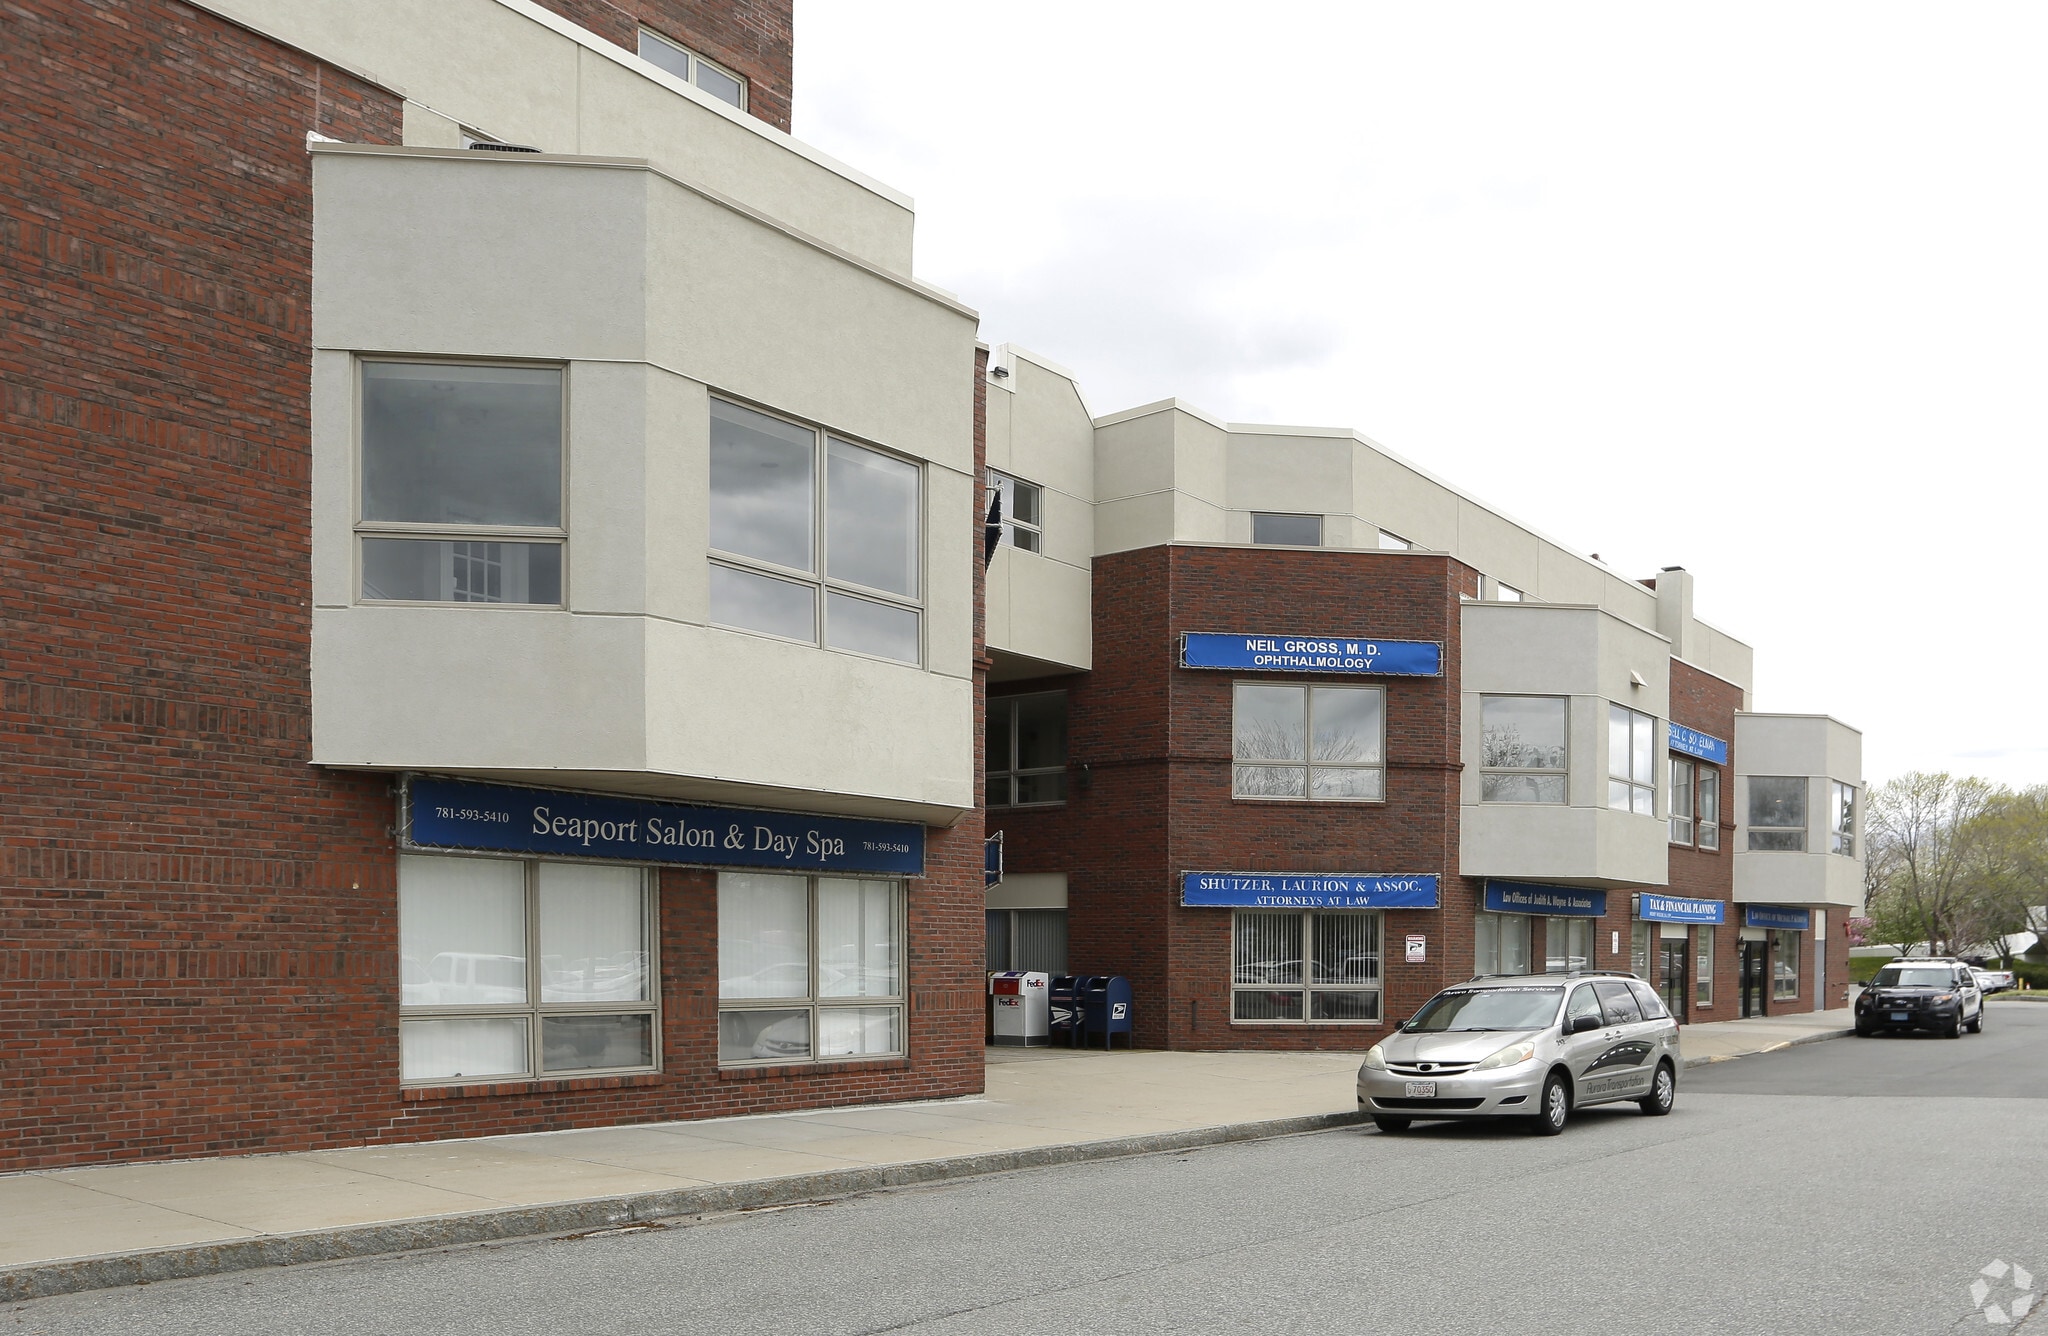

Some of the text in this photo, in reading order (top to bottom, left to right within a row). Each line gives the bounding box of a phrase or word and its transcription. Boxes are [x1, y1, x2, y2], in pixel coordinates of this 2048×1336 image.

[1246, 640, 1381, 656] NEIL GROSS, M. D.
[1254, 655, 1373, 669] OPHTHALMOLOGY
[435, 806, 909, 862] 781-593-5410 Seaport Salon & Day Spa 781-593-5410
[1199, 878, 1422, 892] SHUTZER, LAURION & ASSOC.
[1254, 896, 1370, 905] ATTORNEYS AT LAW
[1502, 891, 1511, 903] Law
[1512, 892, 1527, 904] Offices
[1528, 893, 1533, 904] of
[1533, 894, 1546, 905] Judith
[1552, 895, 1566, 908] Wayne
[1568, 897, 1572, 907] &
[1572, 897, 1592, 908] Associates
[1649, 899, 1717, 914] TAX & FINANCIAL PLANNING
[1026, 979, 1045, 988] FedEx
[998, 998, 1019, 1006] FedEx
[1413, 1085, 1433, 1094] 70350
[1586, 1075, 1645, 1094] Aurora Transportation
